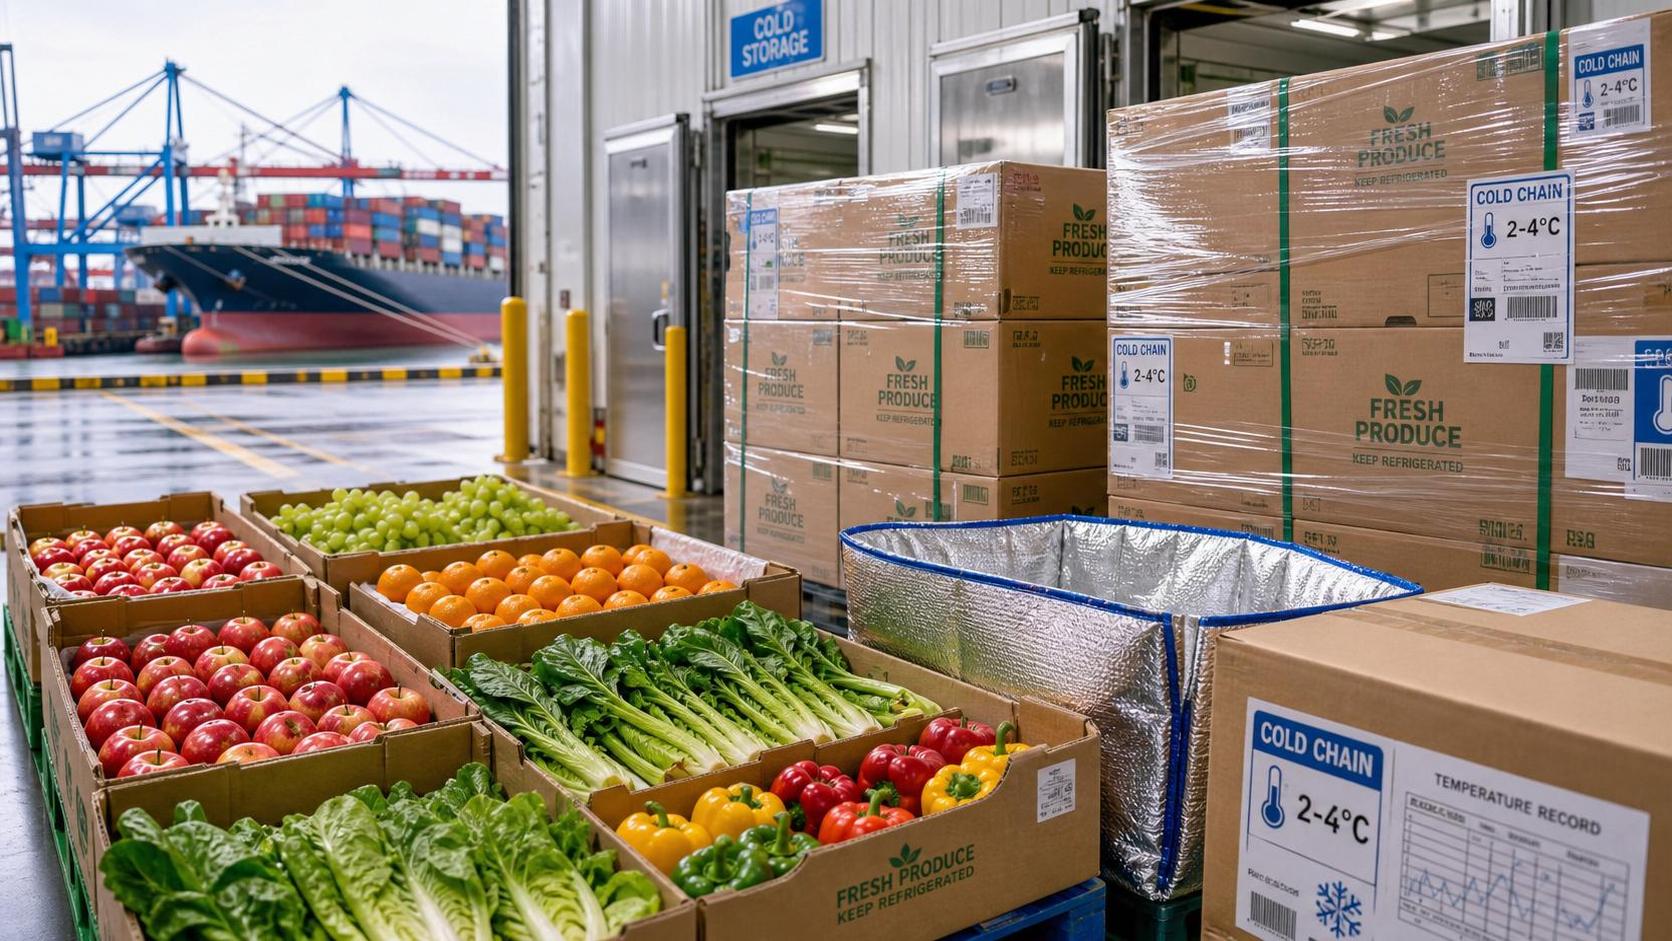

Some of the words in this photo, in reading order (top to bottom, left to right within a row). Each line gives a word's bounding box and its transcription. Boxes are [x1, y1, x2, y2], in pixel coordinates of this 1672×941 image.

[754, 10, 795, 39] COLD
[742, 29, 809, 67] STORAGE
[1578, 57, 1605, 74] COLD
[1607, 50, 1640, 69] CHAIN
[1600, 77, 1638, 97] 2-4°C
[1371, 121, 1432, 146] FRESH
[1357, 140, 1446, 168] PRODUCE
[1476, 188, 1512, 205] COLD
[1517, 183, 1562, 201] CHAIN
[1063, 222, 1107, 240] FRESH
[1506, 216, 1560, 238] 2-4°C
[1052, 240, 1107, 258] PRODUC
[1116, 343, 1138, 356] COLD
[1140, 343, 1167, 356] CHAIN
[765, 367, 796, 382] FRESH
[887, 373, 928, 390] FRESH
[1062, 374, 1106, 391] FRESH
[1134, 369, 1165, 383] 2-4°C
[758, 382, 804, 399] PRODUCE
[1052, 391, 1107, 410] PRODUC
[1370, 398, 1444, 422] FRESH
[1355, 421, 1462, 449] PRODUCE
[1352, 453, 1378, 465] KEEP
[1381, 456, 1464, 473] REFRIGERATED
[765, 494, 796, 511] FRESH
[758, 507, 804, 529] PRODUCE
[1260, 721, 1307, 755] COLD
[1313, 738, 1374, 778] CHAIN
[1434, 773, 1532, 815] TEMPERATURE
[1537, 805, 1602, 836] RECORD
[1297, 794, 1370, 845] 2-4°C
[837, 873, 893, 908] FRESH
[899, 844, 975, 886] PRODUCE
[837, 901, 874, 925] KEEP
[878, 865, 975, 910] REFRIGERATED
